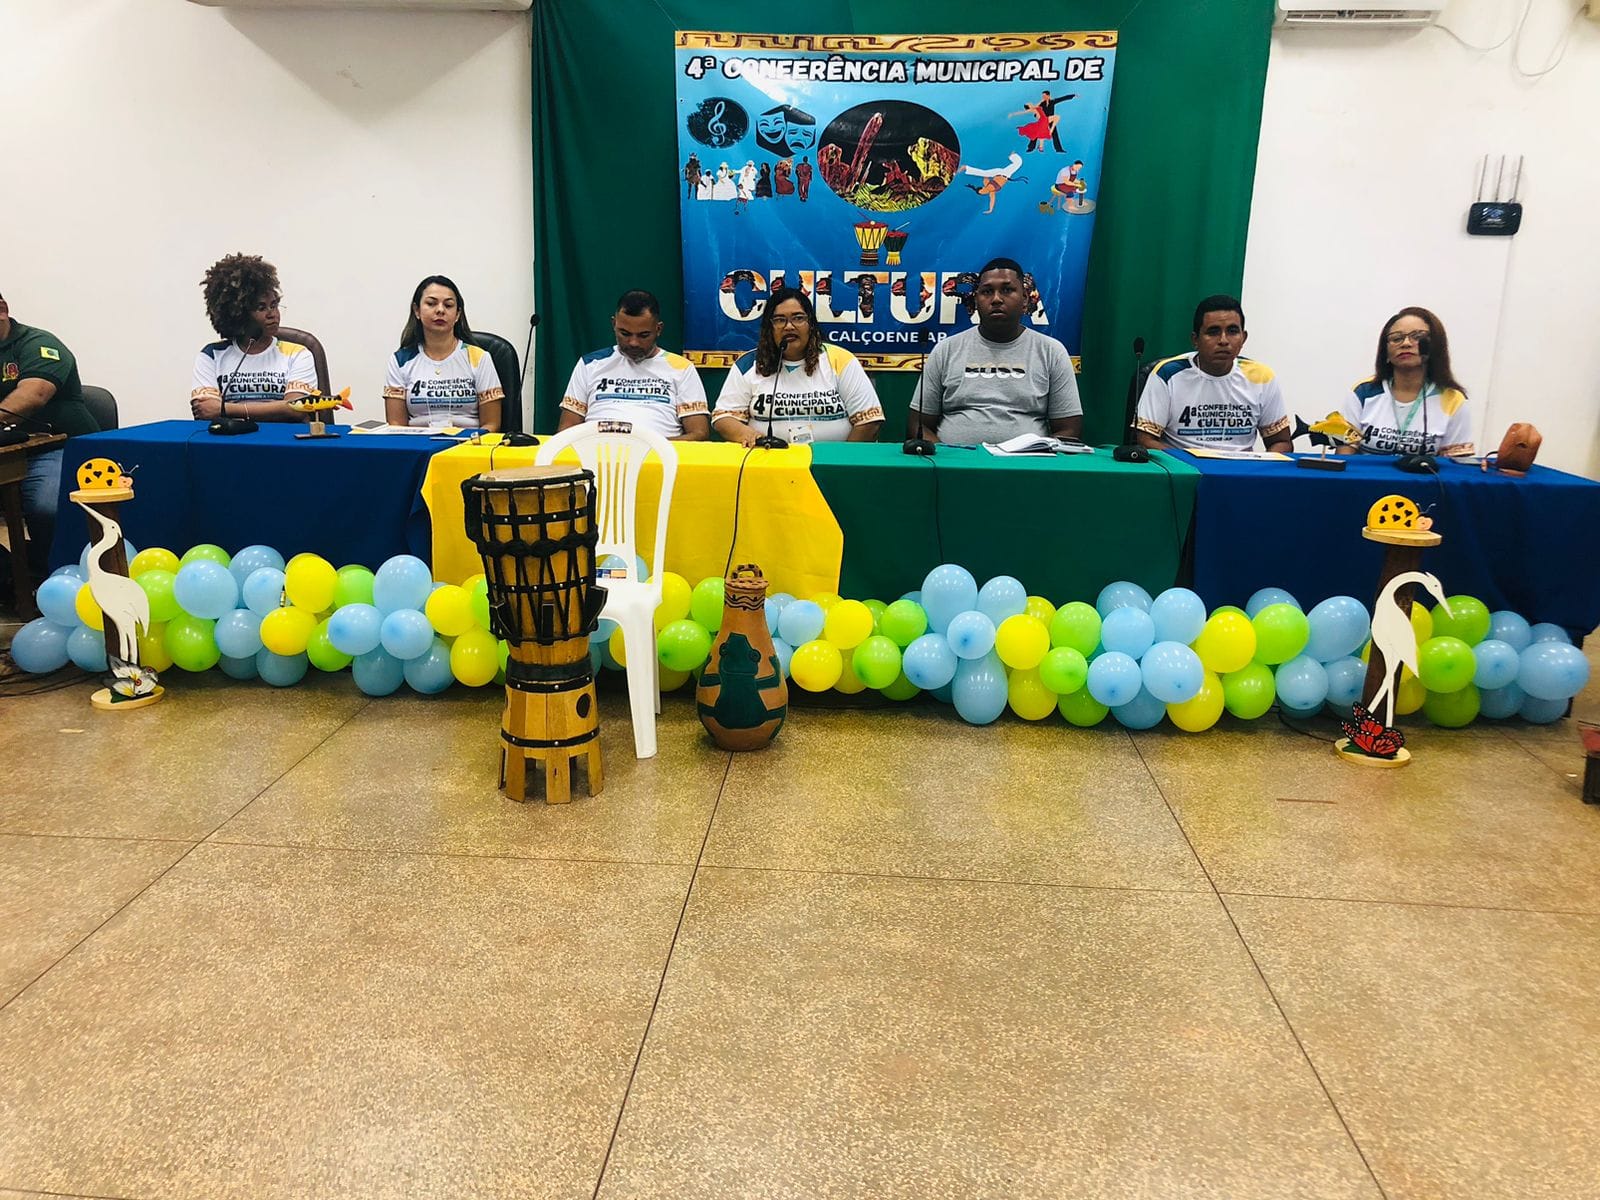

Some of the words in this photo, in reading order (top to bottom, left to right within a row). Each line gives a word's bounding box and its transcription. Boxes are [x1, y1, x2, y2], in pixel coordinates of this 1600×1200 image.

[686, 56, 716, 79] 4ª
[722, 55, 906, 82] CONFERÊNCIA
[914, 58, 1059, 83] MUNICIPAL
[1065, 57, 1104, 82] DE
[828, 330, 918, 345] CALÇOENE
[229, 384, 286, 393] CULTURA
[614, 387, 670, 395] CULTURA
[774, 399, 830, 407] MUNICIPAL
[774, 404, 845, 416] CULTURA
[1178, 405, 1197, 427] 4ª
[1197, 418, 1253, 427] CULTURA
[1375, 440, 1436, 453] CULTUA
